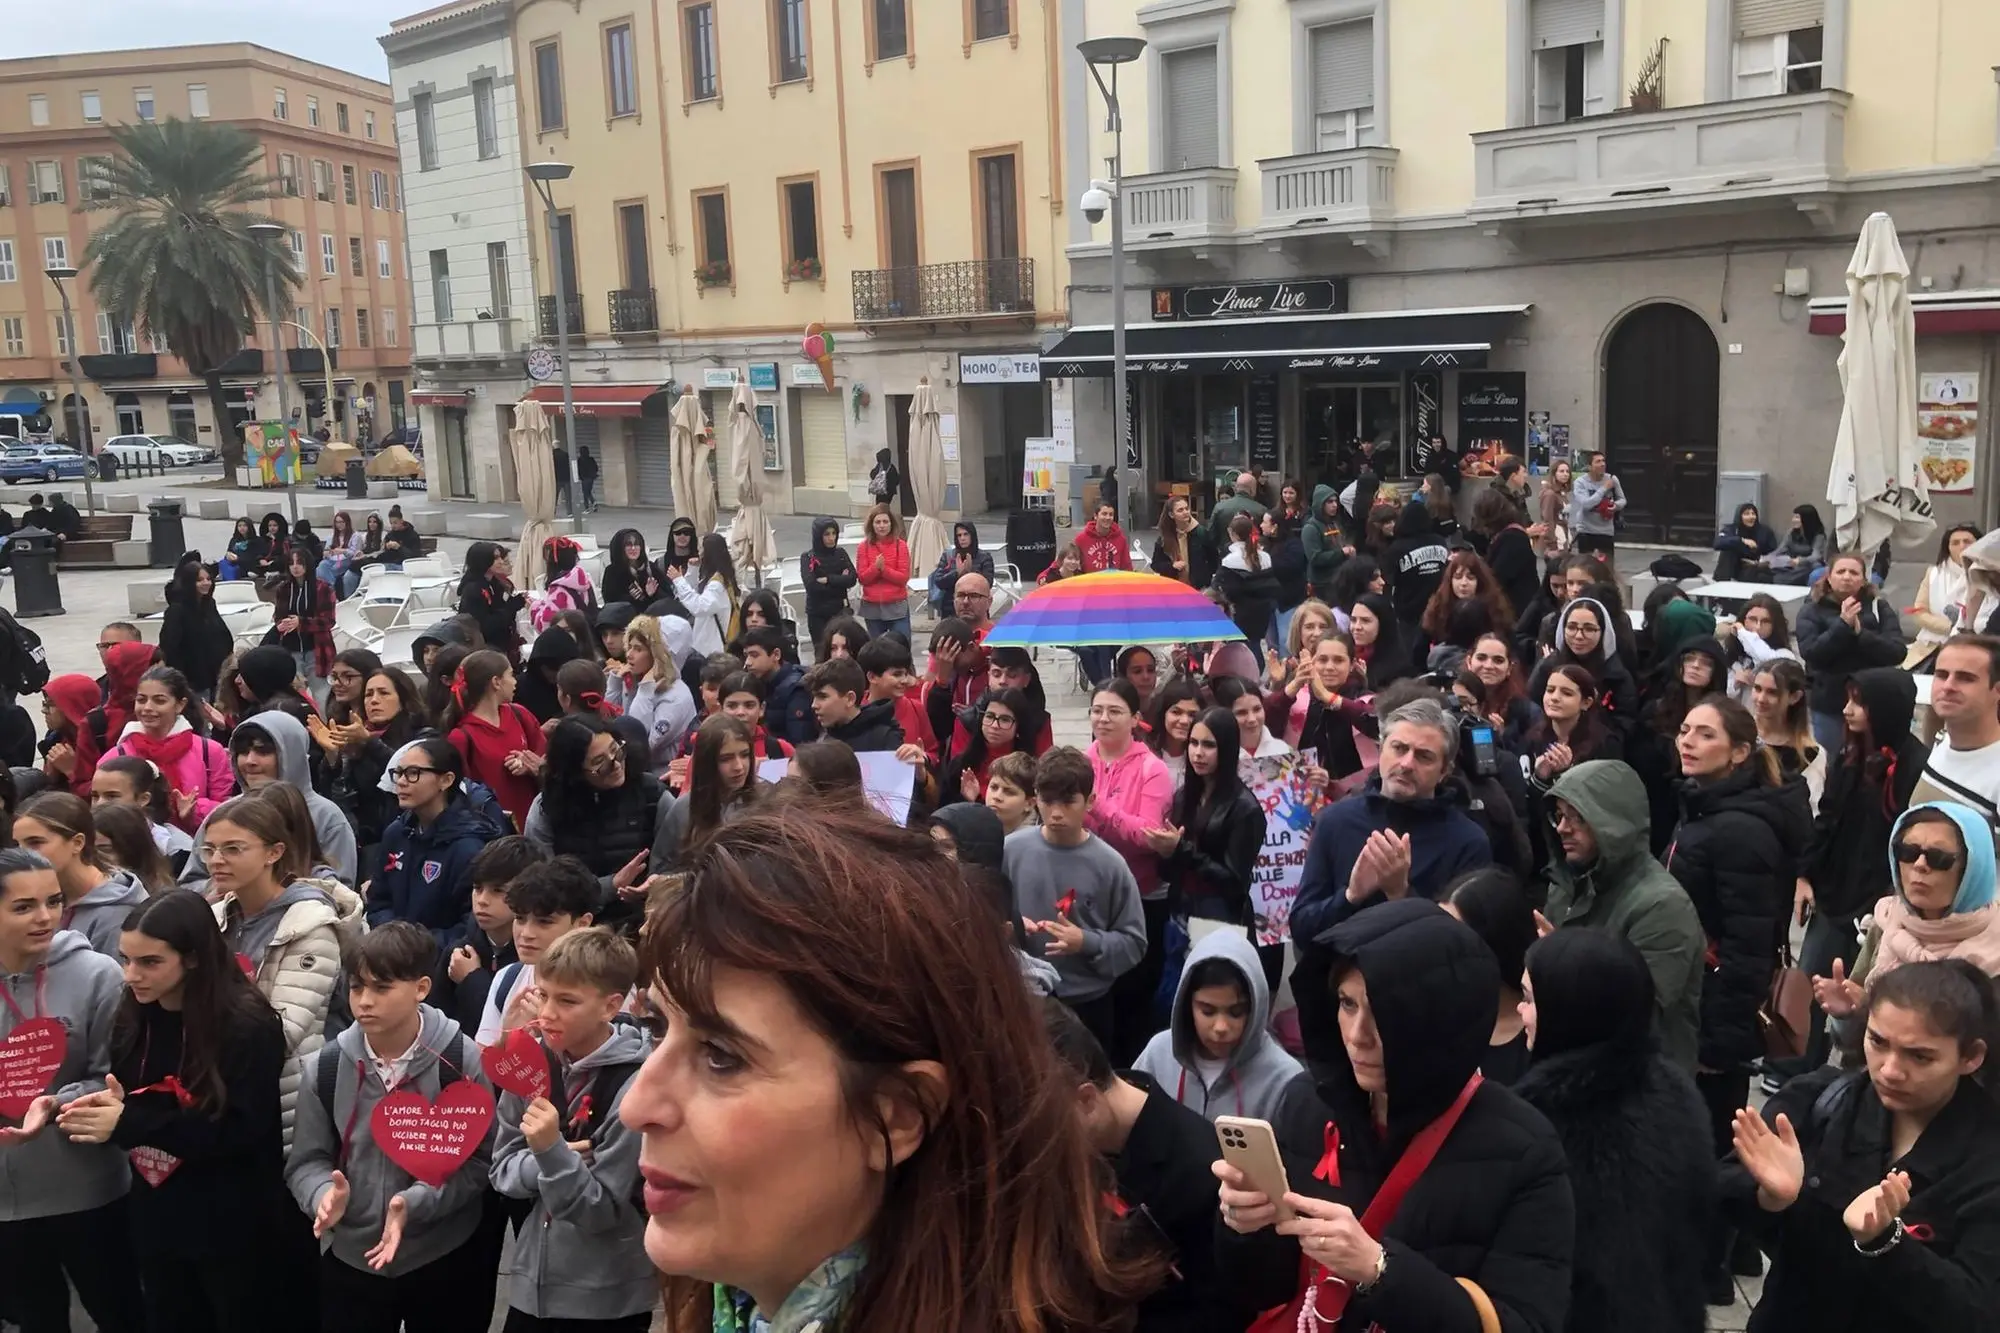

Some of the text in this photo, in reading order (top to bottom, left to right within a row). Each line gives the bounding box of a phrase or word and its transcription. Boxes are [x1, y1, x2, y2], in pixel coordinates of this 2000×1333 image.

[1211, 284, 1306, 316] Linas Live
[963, 362, 1038, 375] MOMO TEA
[1251, 869, 1284, 883] ULLE
[8, 1029, 49, 1044] NON TI FA
[0, 1049, 24, 1058] EGLIO
[514, 1065, 533, 1080] MANI
[384, 1106, 422, 1116] L'AMORE
[455, 1106, 476, 1114] ARMA
[479, 1106, 486, 1114] A
[431, 1133, 443, 1142] MA
[399, 1142, 426, 1152] ANCHE
